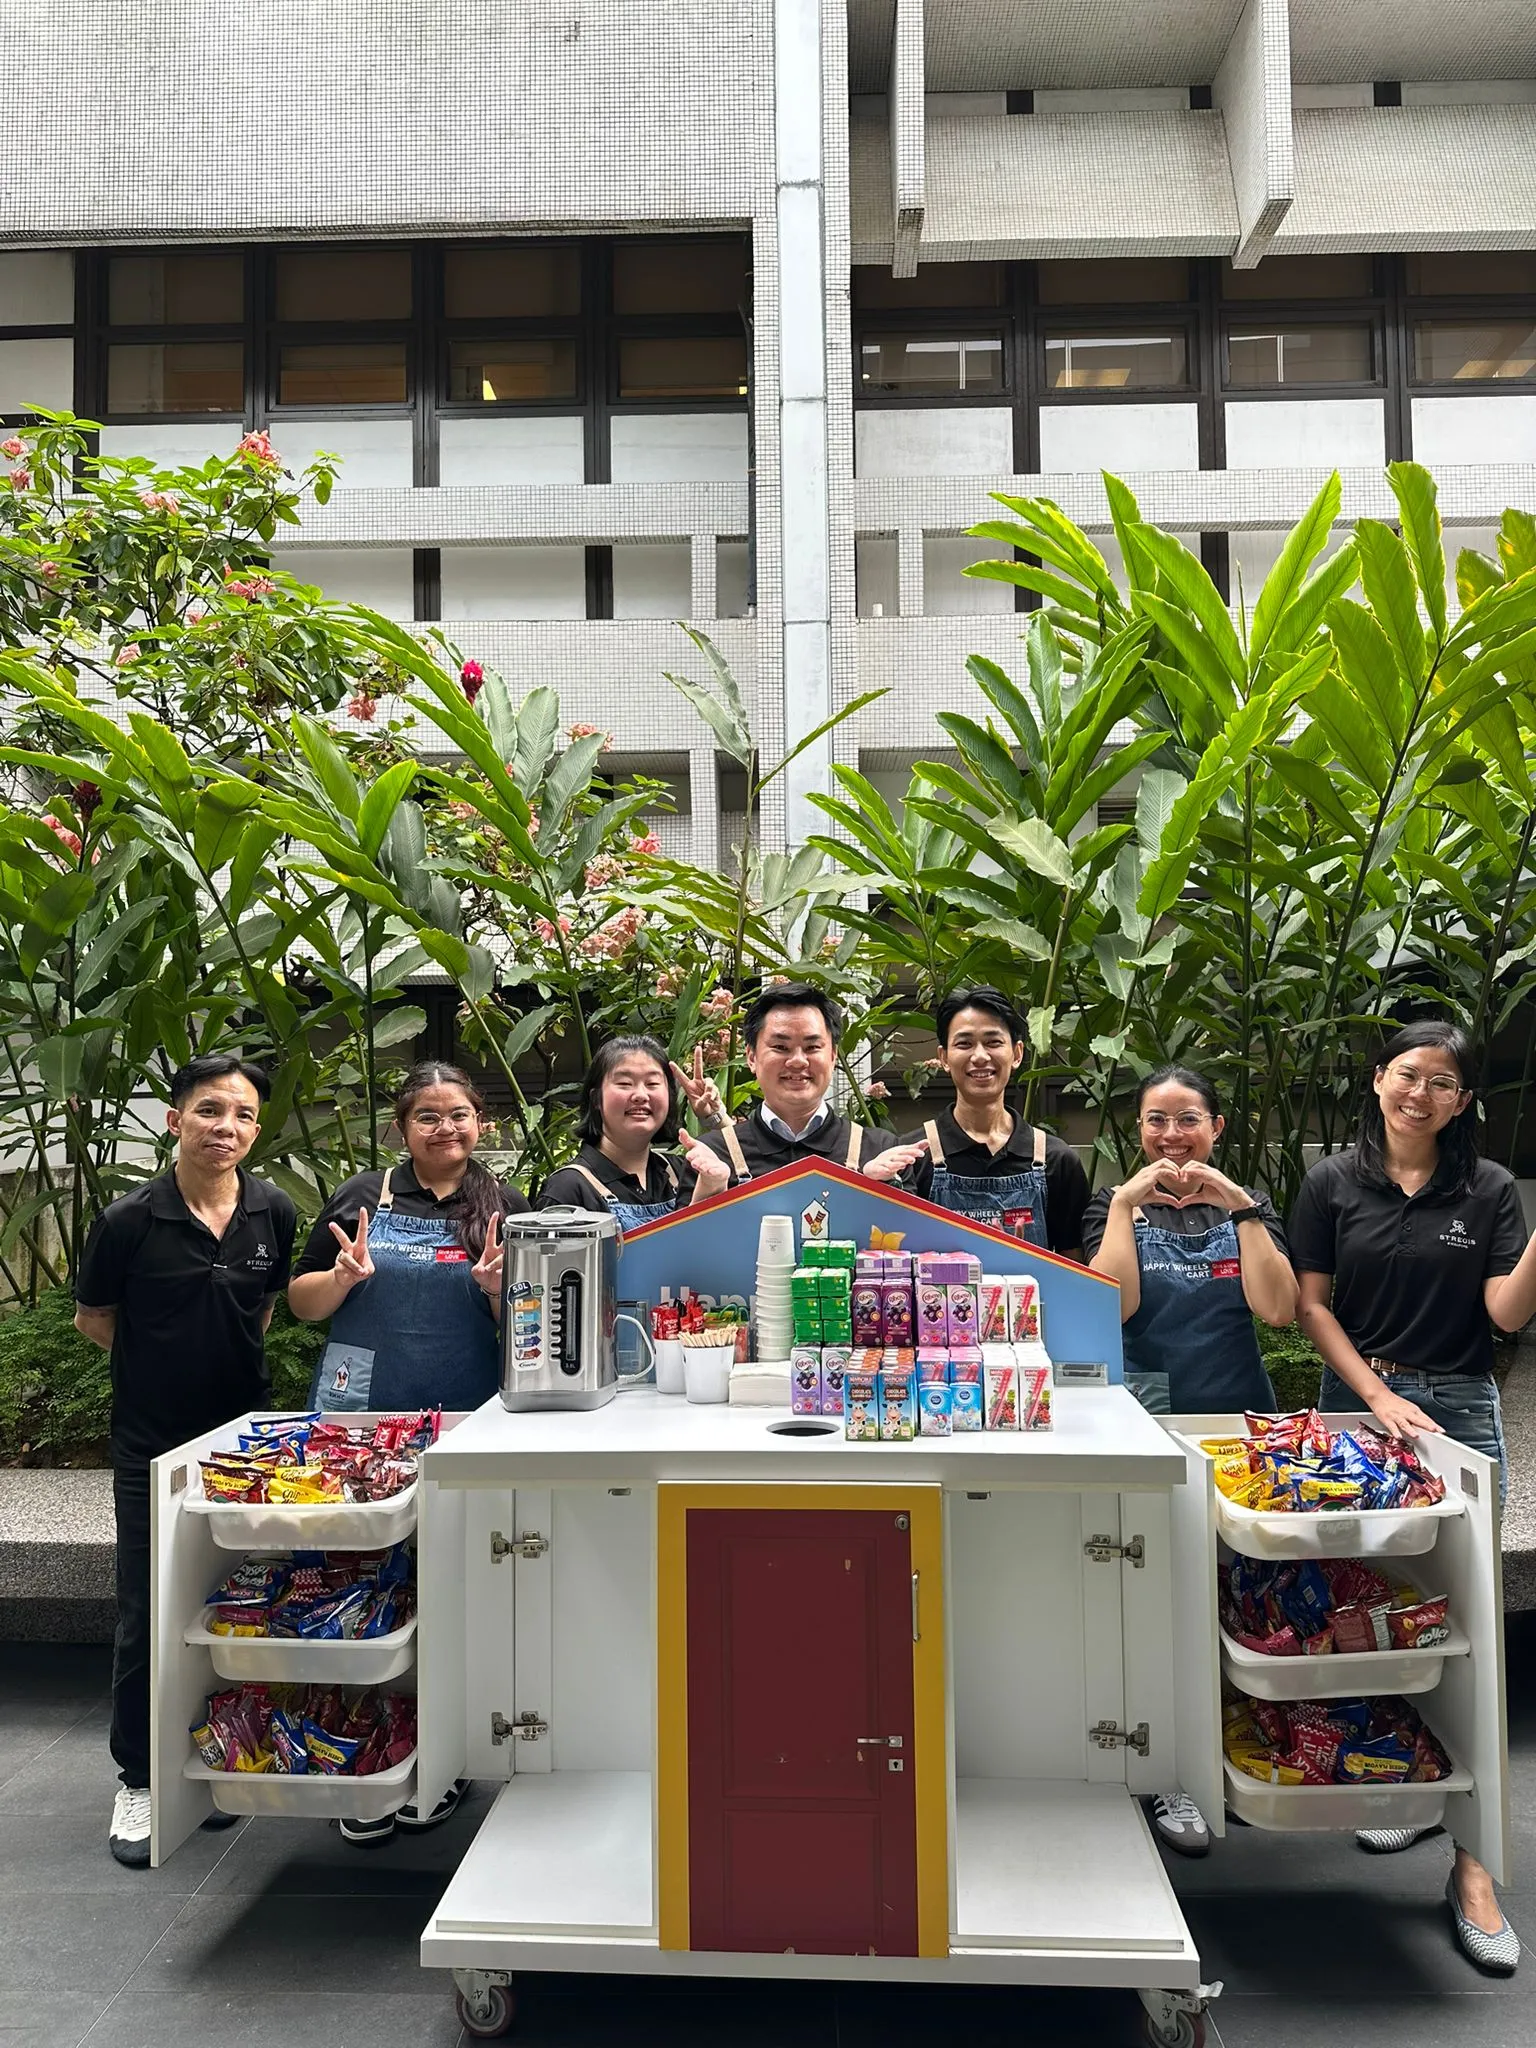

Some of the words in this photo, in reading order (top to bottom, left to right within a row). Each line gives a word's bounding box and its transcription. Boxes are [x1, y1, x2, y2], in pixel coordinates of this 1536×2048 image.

[369, 1241, 398, 1250] HAPPY
[398, 1243, 433, 1253] WHEELS
[1143, 1262, 1171, 1271] HAPPY
[1172, 1262, 1209, 1271] WHEELS
[512, 1282, 529, 1293] 5.0L
